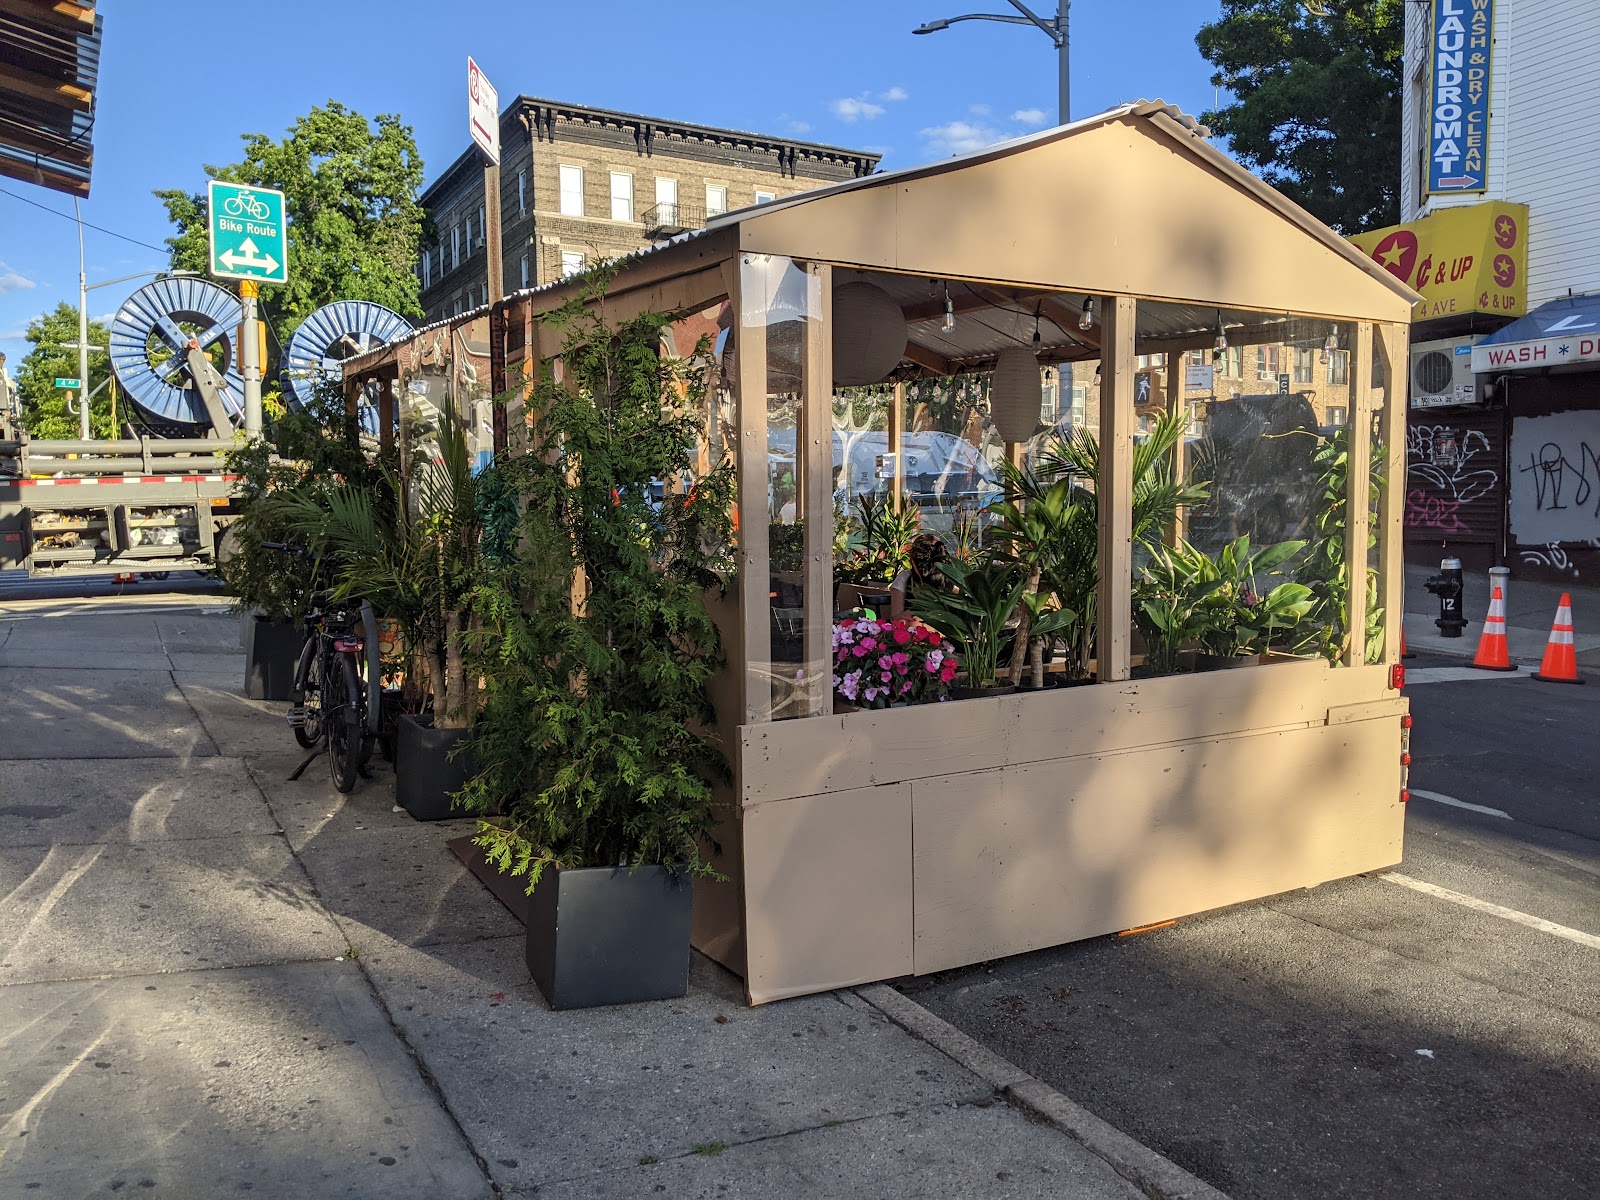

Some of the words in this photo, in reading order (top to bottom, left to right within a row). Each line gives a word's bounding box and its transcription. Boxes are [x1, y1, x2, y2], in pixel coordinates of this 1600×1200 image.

[1470, 0, 1489, 48] WASH
[1469, 52, 1486, 64] &
[1433, 0, 1466, 173] LAUNDROMAT
[1468, 68, 1485, 104] DRY
[1465, 110, 1482, 172] CLEAN
[220, 219, 243, 232] Bike
[247, 222, 277, 237] Route
[1435, 262, 1446, 284] &
[1450, 256, 1474, 281] UP
[1420, 303, 1427, 316] 4
[1432, 299, 1456, 315] AVE
[1493, 294, 1500, 308] &
[1503, 295, 1516, 309] UP
[1489, 345, 1547, 365] WASH
[1580, 339, 1600, 355] D
[1442, 598, 1455, 610] 12
